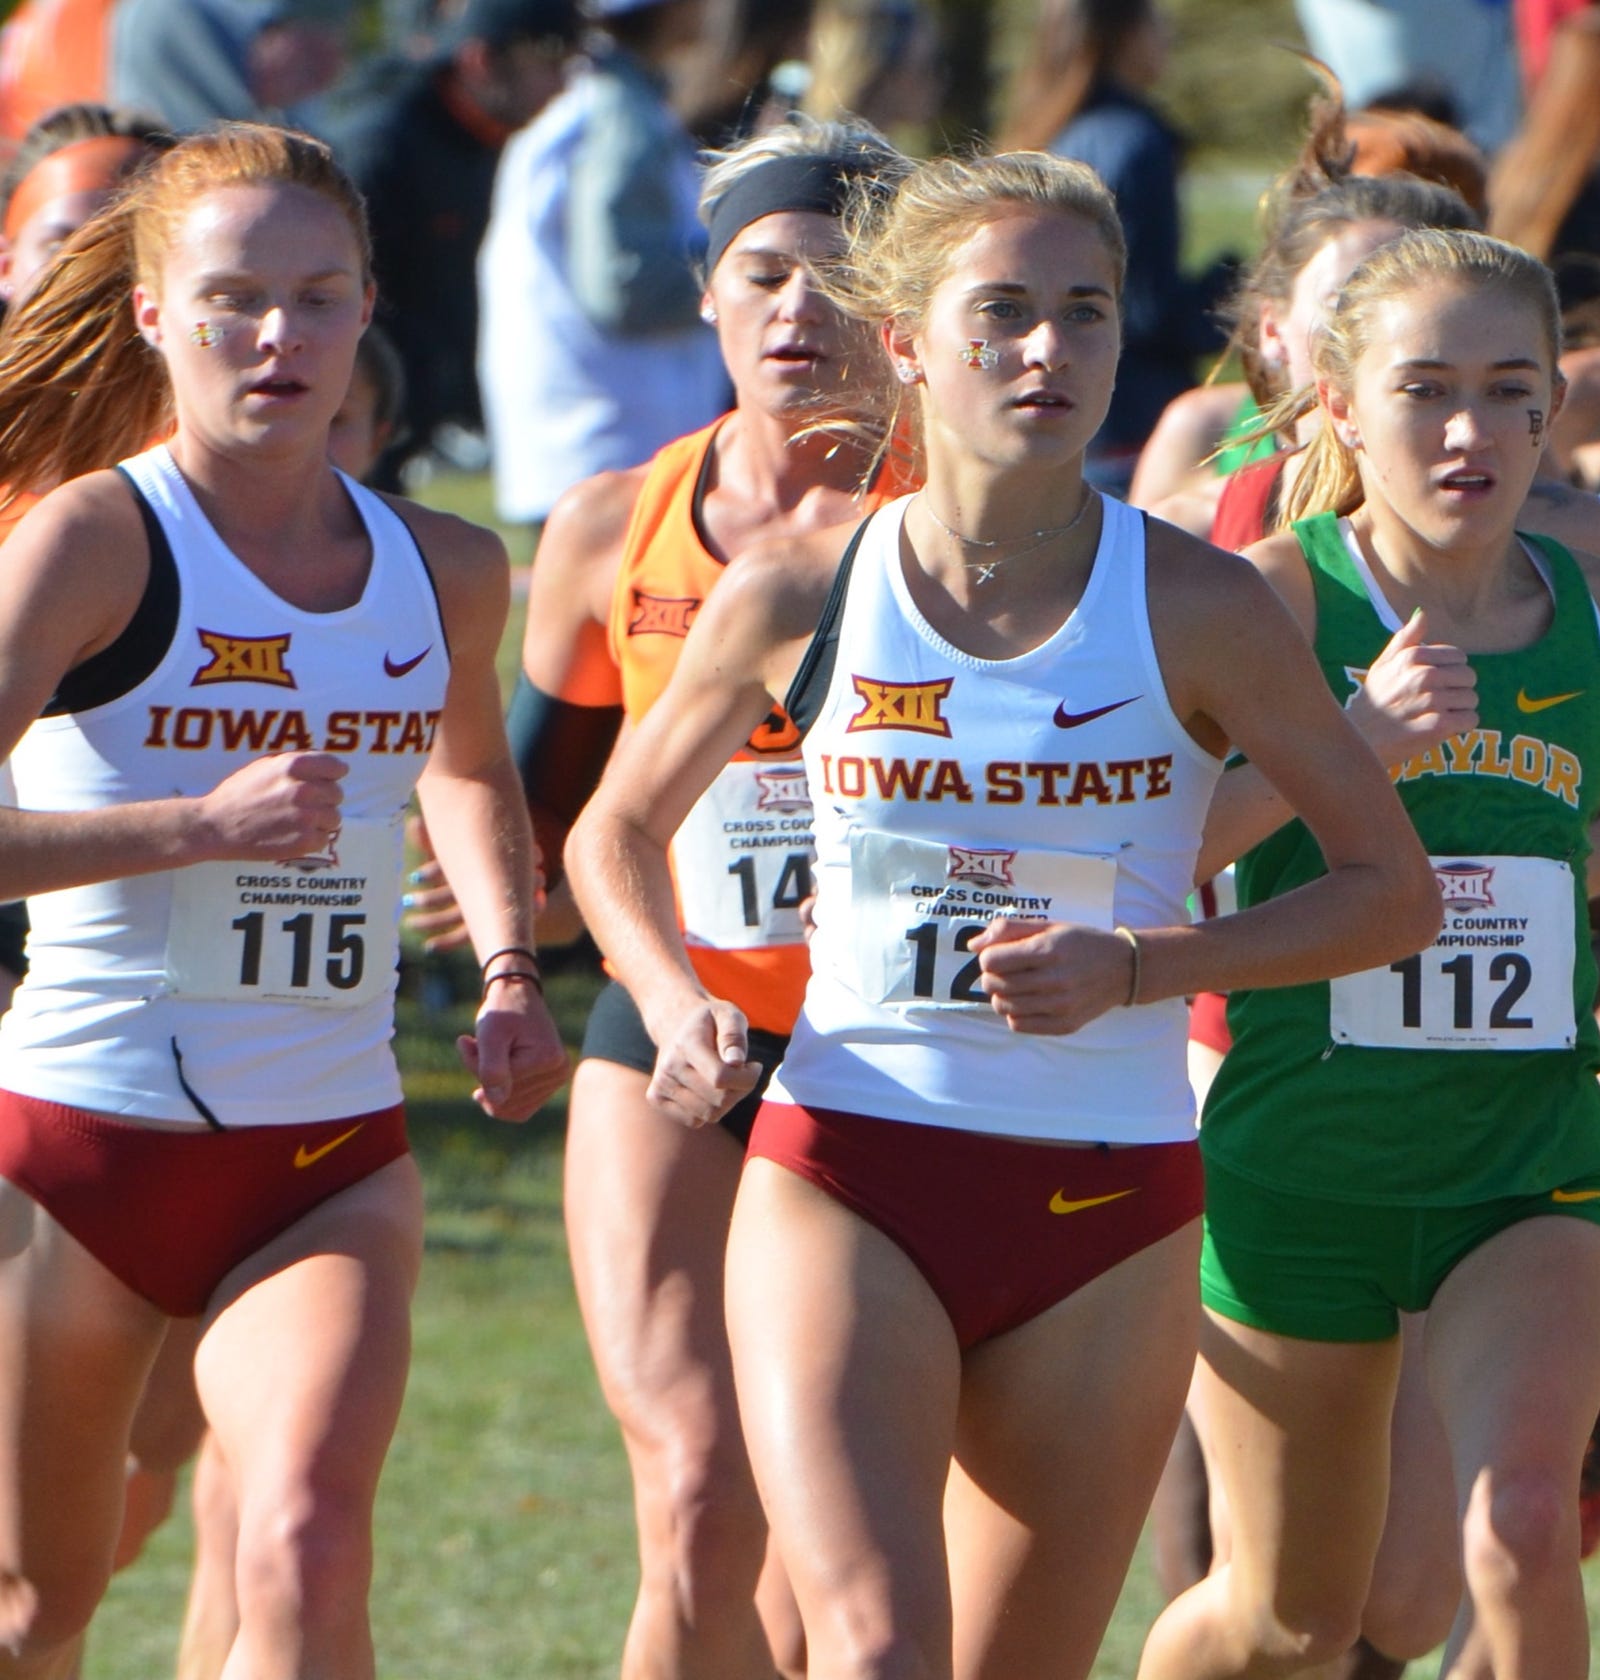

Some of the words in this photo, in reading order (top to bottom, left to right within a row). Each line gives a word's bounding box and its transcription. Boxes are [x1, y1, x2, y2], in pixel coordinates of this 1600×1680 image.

[191, 628, 297, 689] XII
[144, 705, 312, 751] IOWA
[846, 674, 954, 739] XII
[821, 754, 972, 803] IOWA
[986, 753, 1173, 807] STATE
[1388, 728, 1582, 809] AYLOR
[723, 820, 776, 833] CROSS
[236, 874, 291, 889] CROSS
[296, 876, 367, 891] COUNTRY
[240, 891, 362, 906] CHAMPIONSHIP
[727, 853, 812, 927] 14
[911, 885, 967, 902] CROSS
[972, 891, 1052, 910] COUNTRY
[1432, 934, 1525, 947] MPIONSHIP
[1453, 917, 1528, 931] COUNTRY
[232, 911, 367, 990] 115
[1390, 952, 1533, 1030] 112
